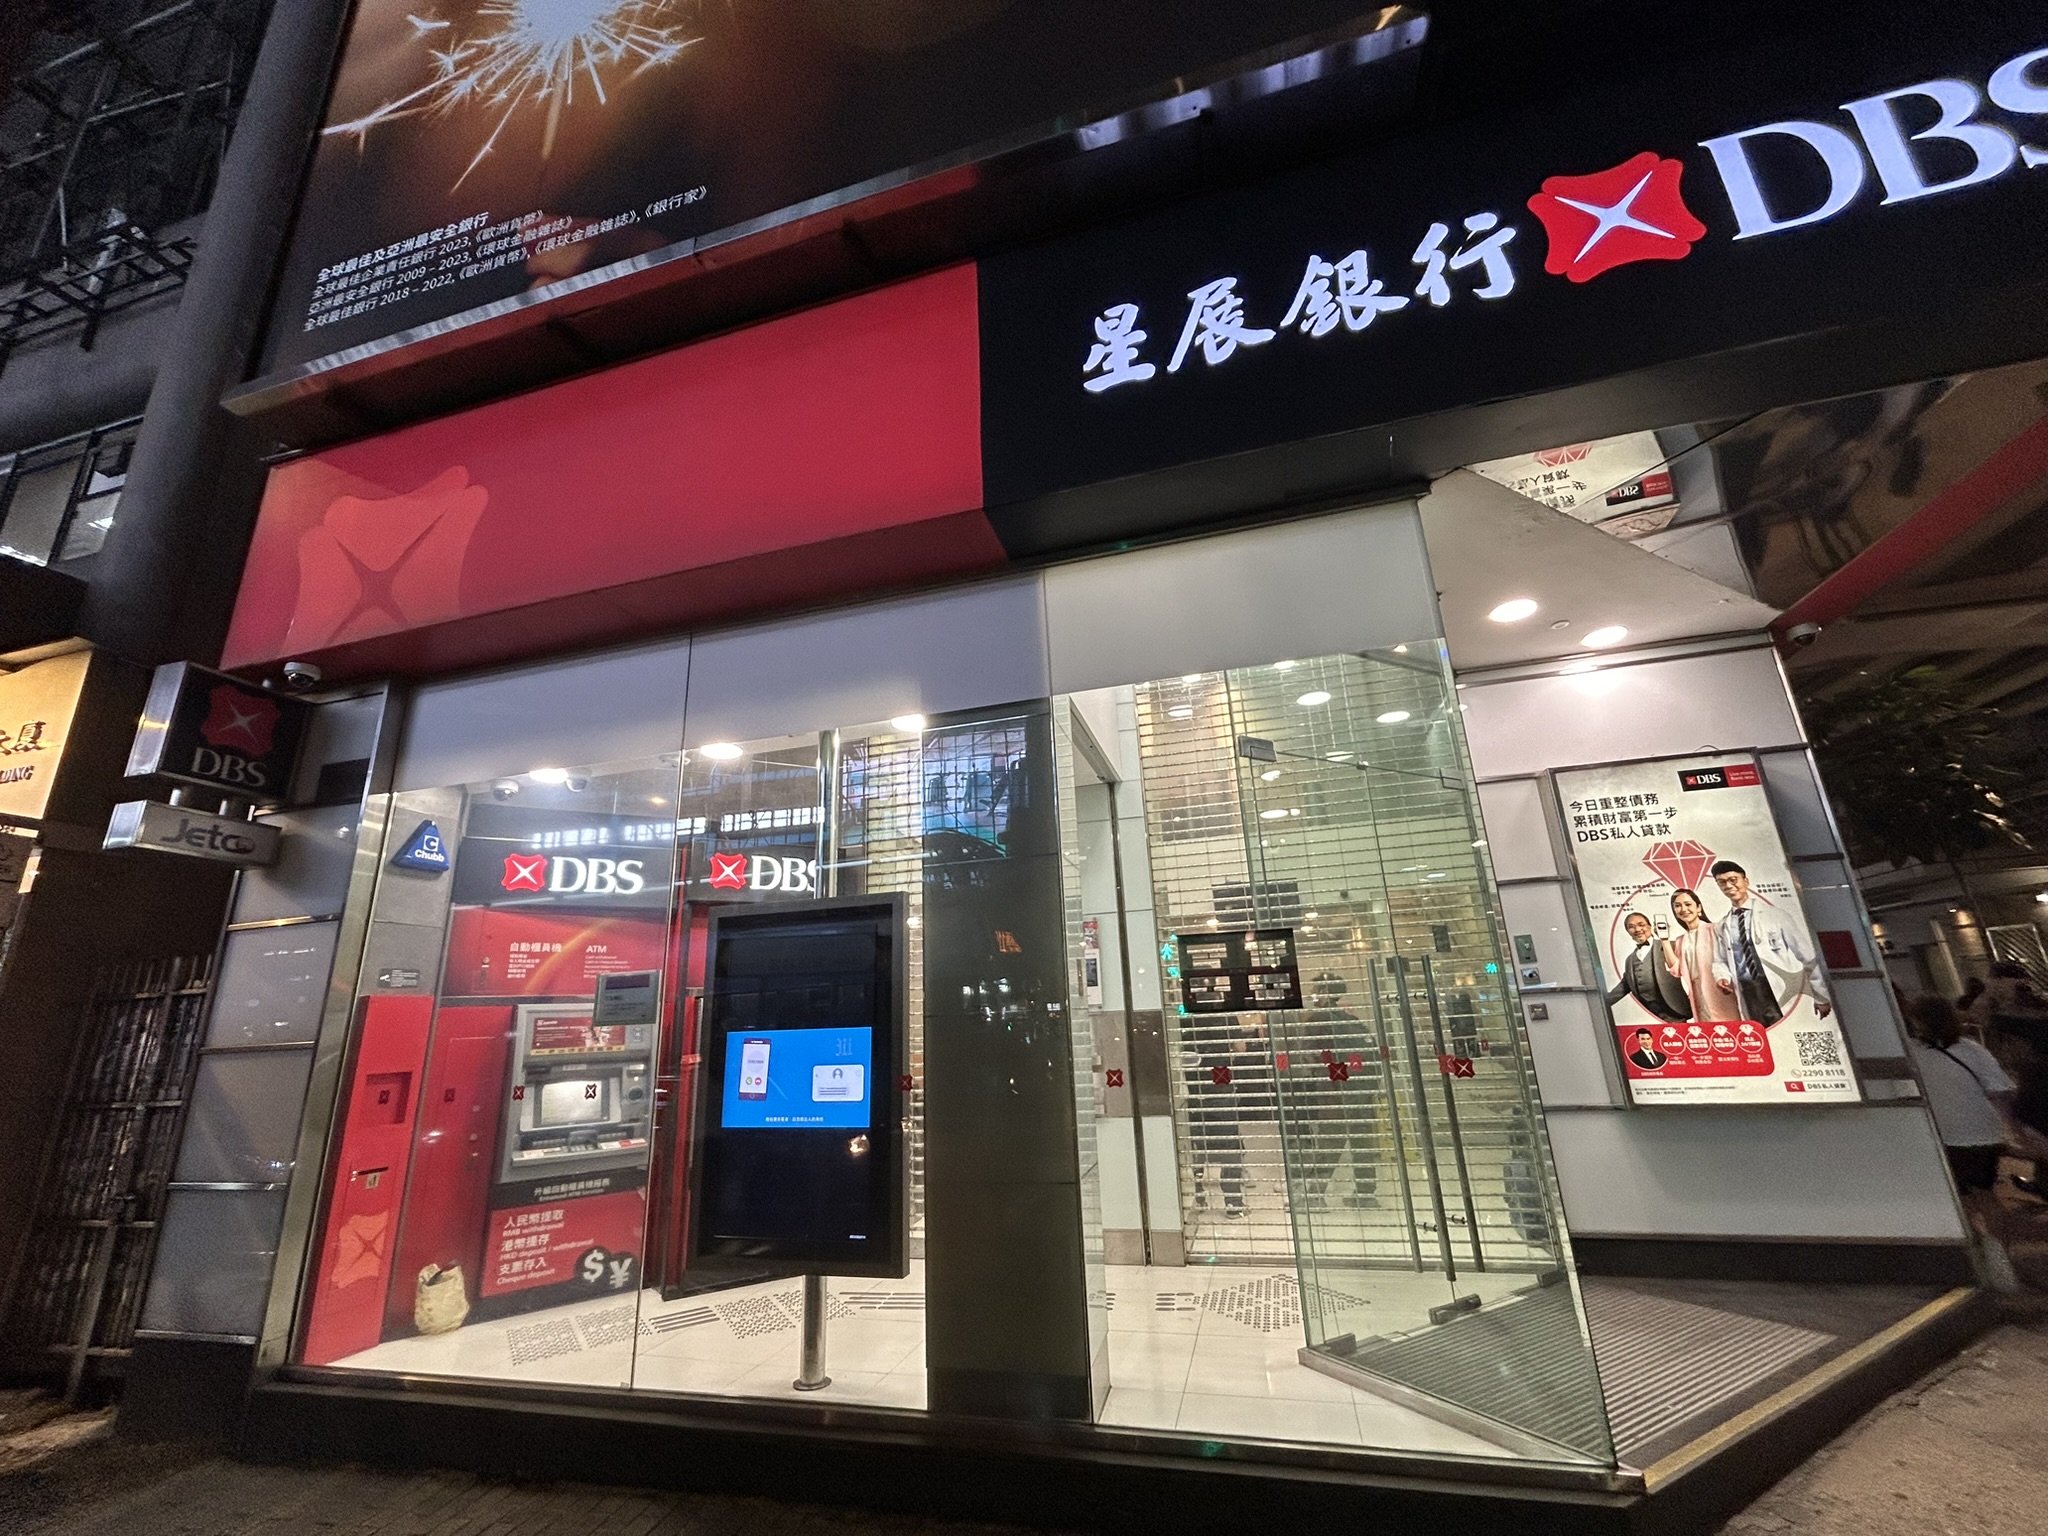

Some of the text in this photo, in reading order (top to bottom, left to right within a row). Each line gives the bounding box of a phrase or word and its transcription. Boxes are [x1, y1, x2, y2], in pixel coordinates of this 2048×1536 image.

[438, 236, 472, 255] 2023,
[396, 266, 426, 285] 2009
[438, 251, 472, 270] 2023,
[380, 287, 410, 306] 2018
[421, 272, 455, 292] 2022,
[1083, 211, 1517, 393] 星展銀行
[191, 747, 267, 787] DBS
[1696, 773, 1721, 784] DBS
[1569, 793, 1659, 812] 今日重整債務
[1573, 806, 1678, 828] 累積財富第一步
[1577, 823, 1671, 842] DBS私人貸款
[414, 848, 445, 862] Chubb
[548, 855, 644, 894] DBS
[586, 945, 607, 953] ATM
[1802, 1069, 1824, 1077] 2290
[503, 1229, 521, 1237] RMB
